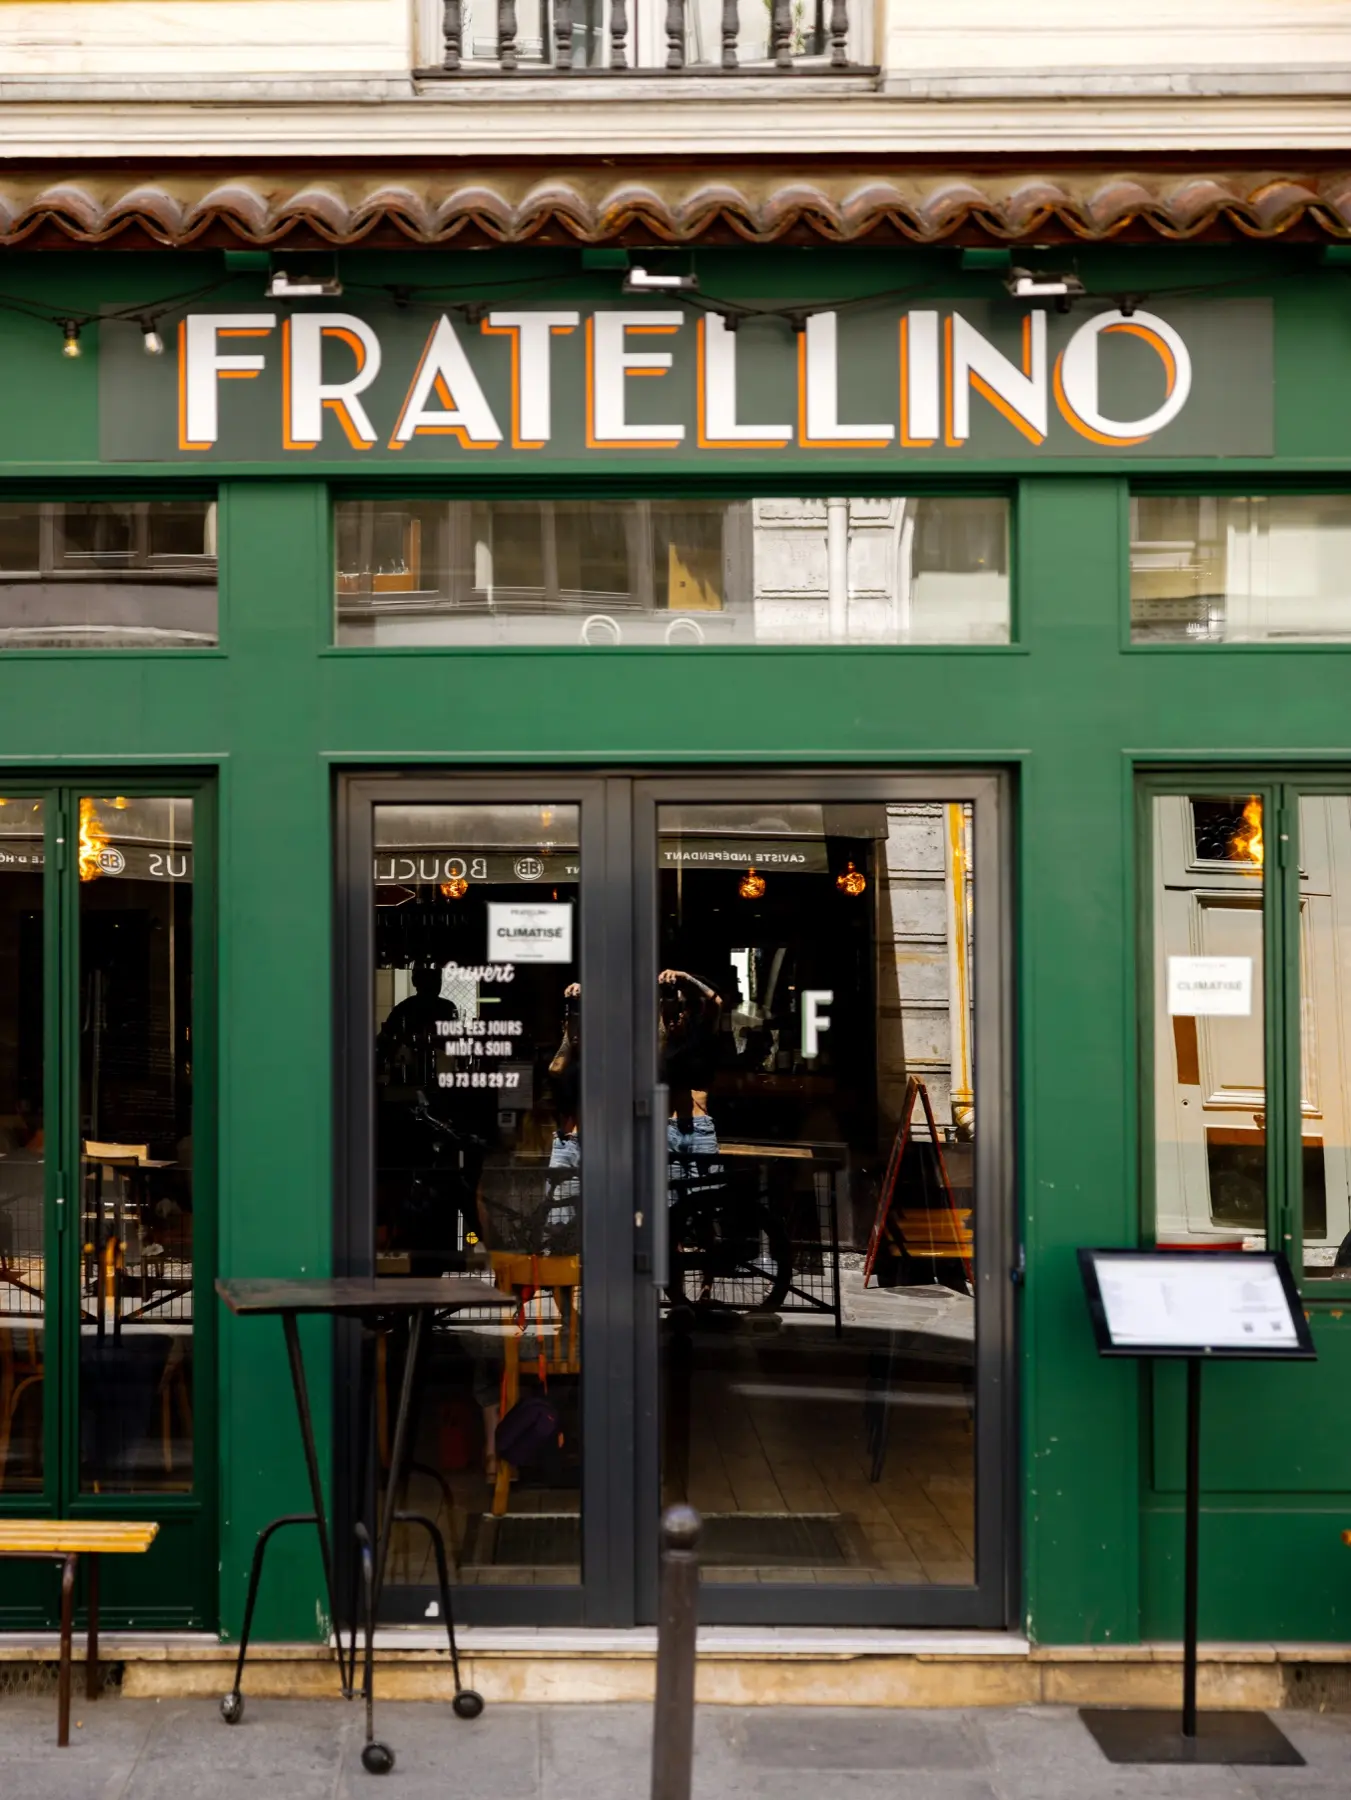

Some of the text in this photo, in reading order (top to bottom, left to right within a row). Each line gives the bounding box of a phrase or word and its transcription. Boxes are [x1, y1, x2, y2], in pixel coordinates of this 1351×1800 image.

[178, 310, 1193, 450] FRATELLINO
[444, 960, 516, 983] Ouvert
[435, 1020, 523, 1036] TOUS LES JOURS
[801, 989, 834, 1058] F
[445, 1040, 513, 1056] MIDI & SOIR
[438, 1072, 520, 1088] 09 73 88 29 27
